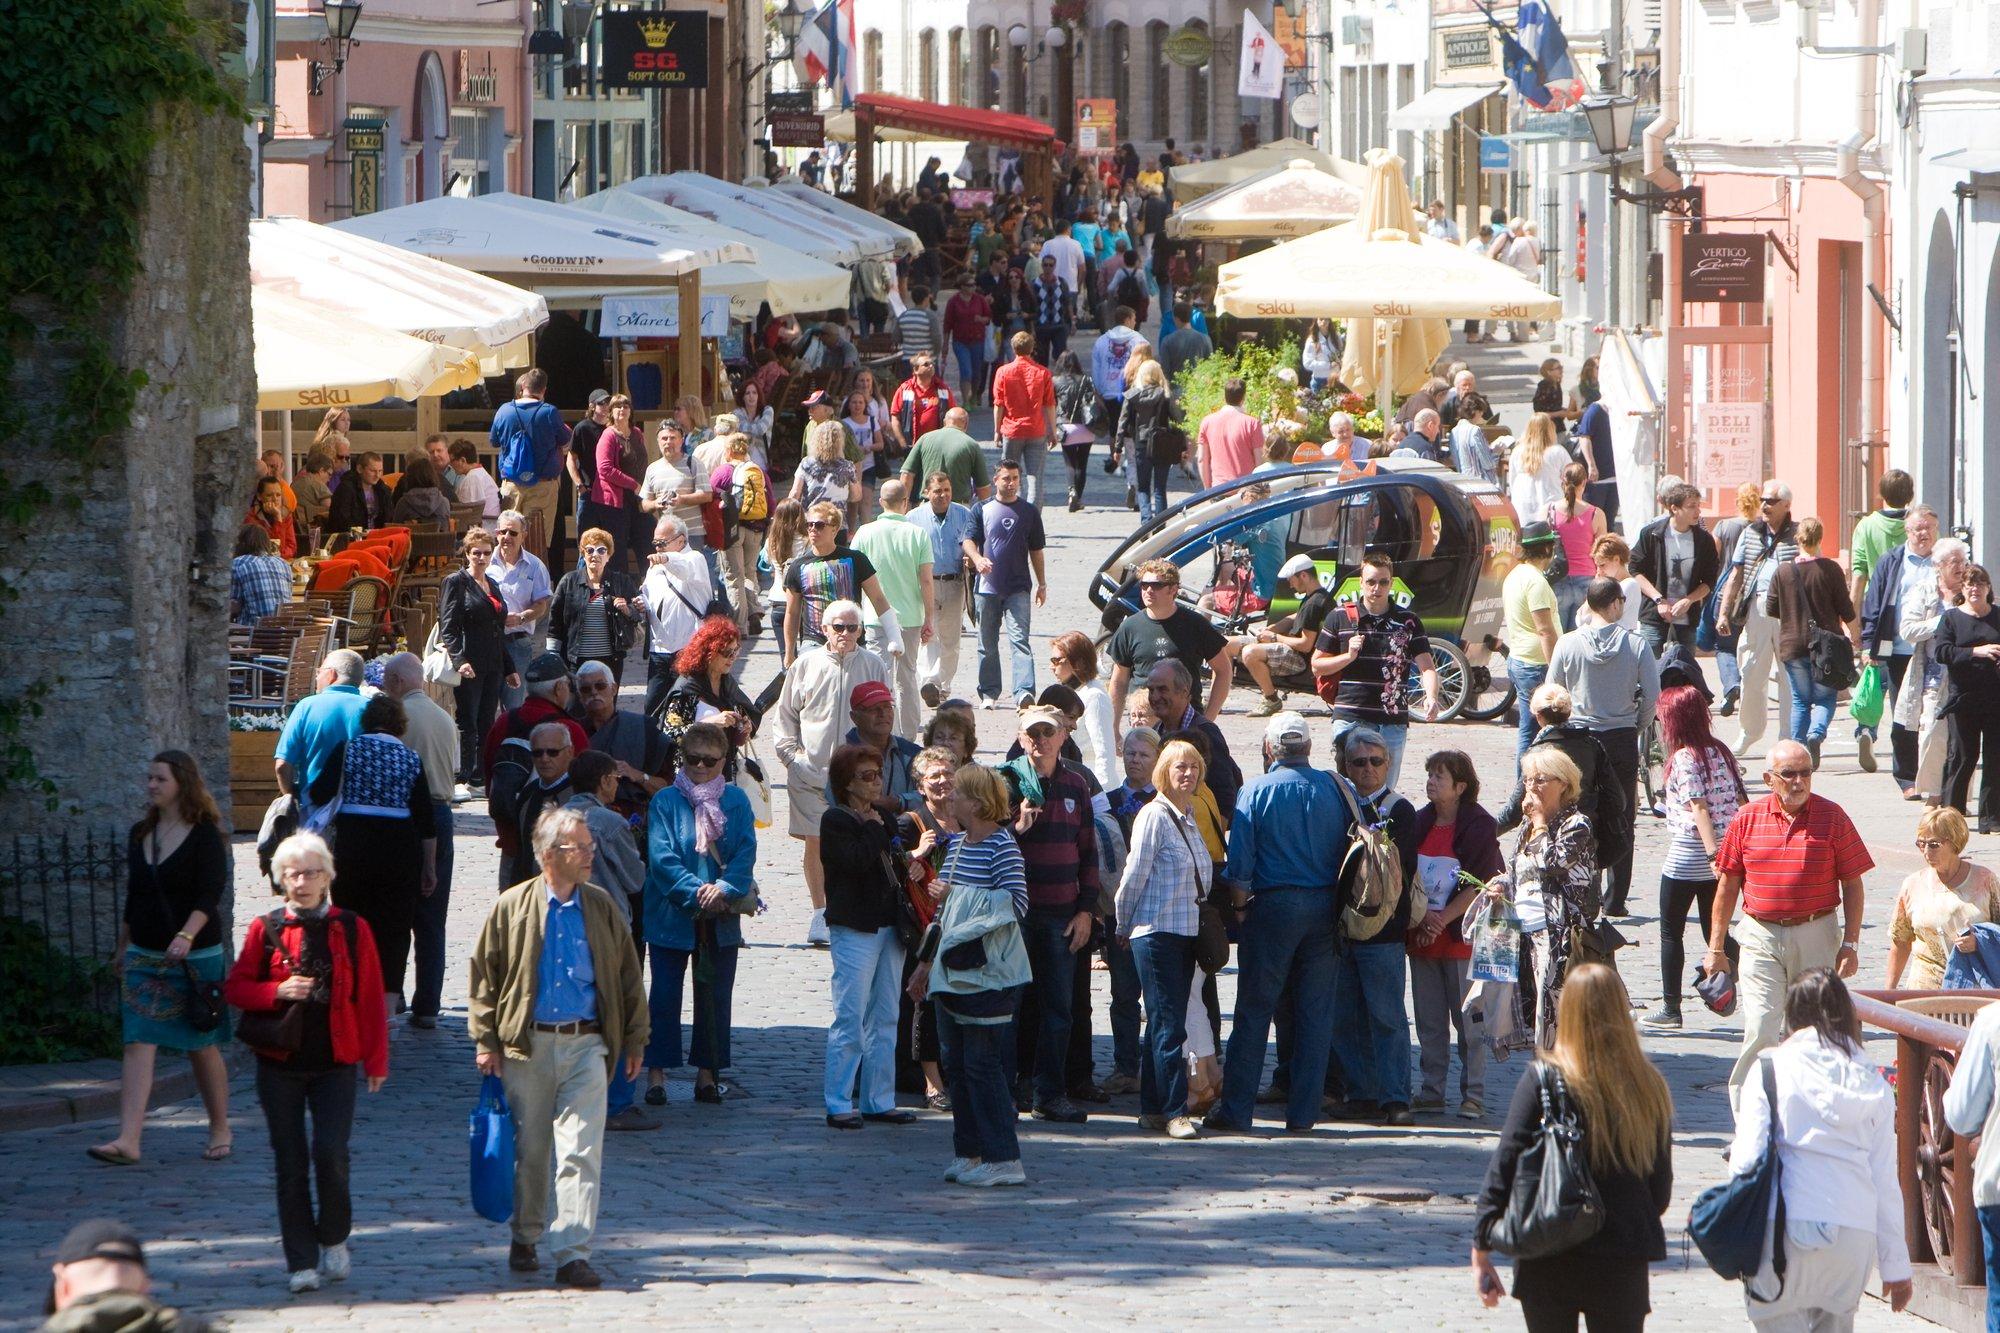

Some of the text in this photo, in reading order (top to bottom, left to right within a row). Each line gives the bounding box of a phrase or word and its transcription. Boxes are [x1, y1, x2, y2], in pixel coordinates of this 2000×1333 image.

[1447, 41, 1489, 56] ANTIQUE
[633, 52, 678, 70] SG
[627, 71, 686, 81] SOFT GOLD
[360, 159, 371, 210] BAAR
[530, 254, 597, 266] GOODWIN
[1702, 247, 1747, 257] VERTIGO
[1690, 257, 1751, 277] Gourmet
[1256, 299, 1296, 315] saku
[1372, 300, 1412, 316] saku
[1489, 302, 1529, 318] saku
[616, 311, 678, 327] Maret
[298, 384, 350, 405] saku
[1708, 415, 1750, 427] DELI
